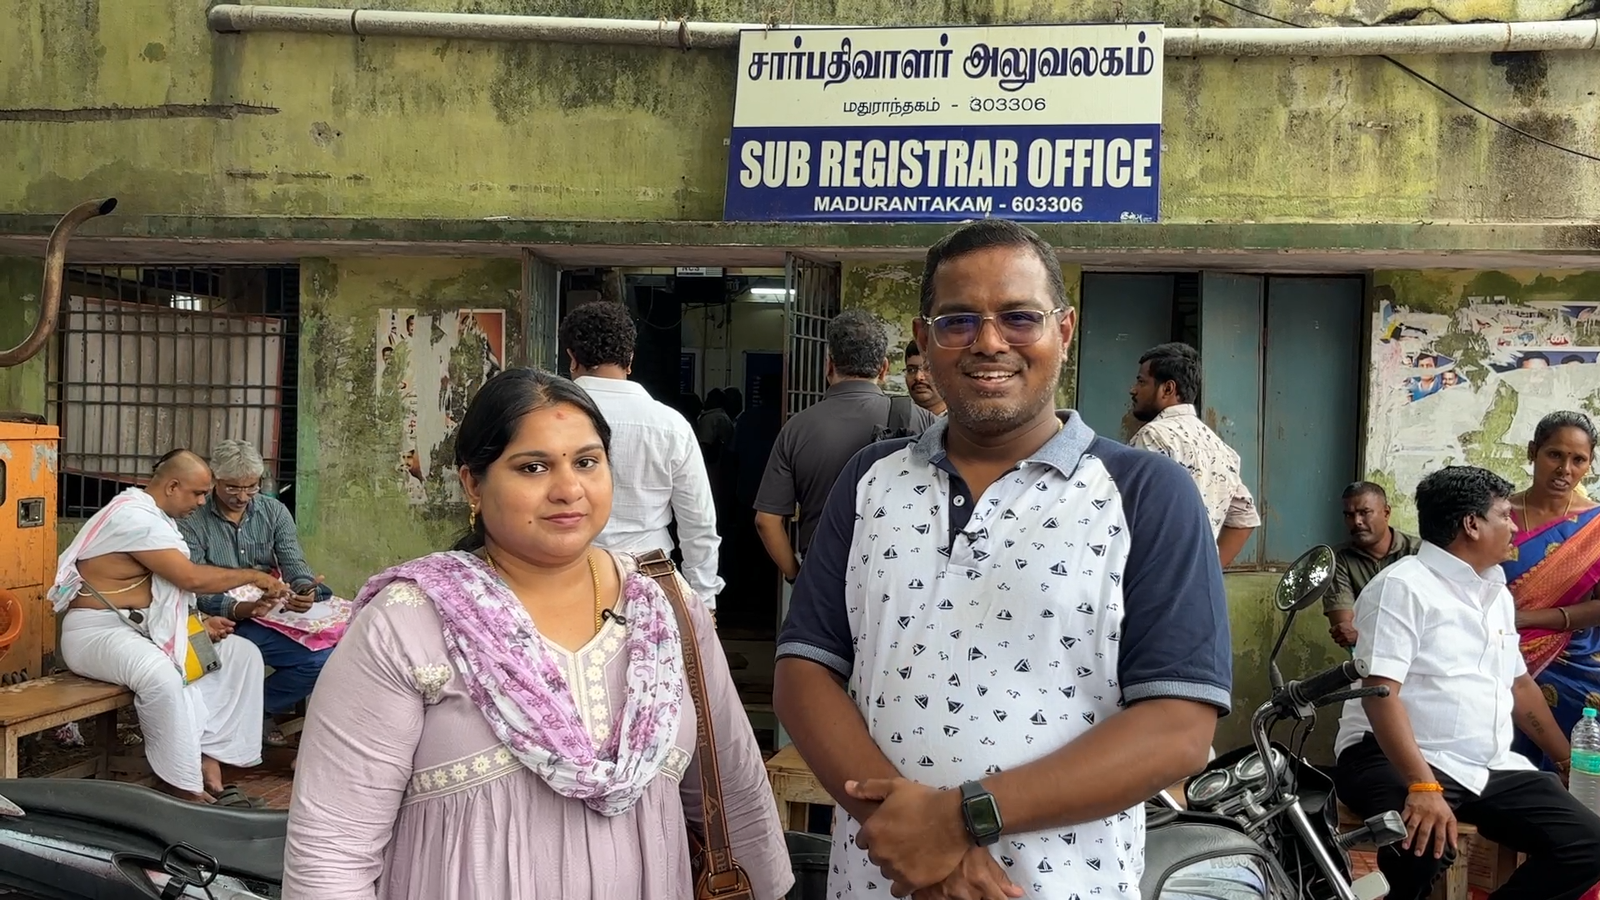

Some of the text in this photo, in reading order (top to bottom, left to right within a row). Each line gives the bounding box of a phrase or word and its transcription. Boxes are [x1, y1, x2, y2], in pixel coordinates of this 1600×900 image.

[748, 31, 1154, 92] சார்பதிவாளர் அலுவலகம்
[843, 97, 940, 117] மதுராந்தகம்
[740, 137, 1153, 188] SUB REGISTRAR OFFICE
[813, 196, 992, 212] MADURANTAKAM
[1011, 196, 1083, 212] 603306
[1526, 711, 1545, 735] MGR
